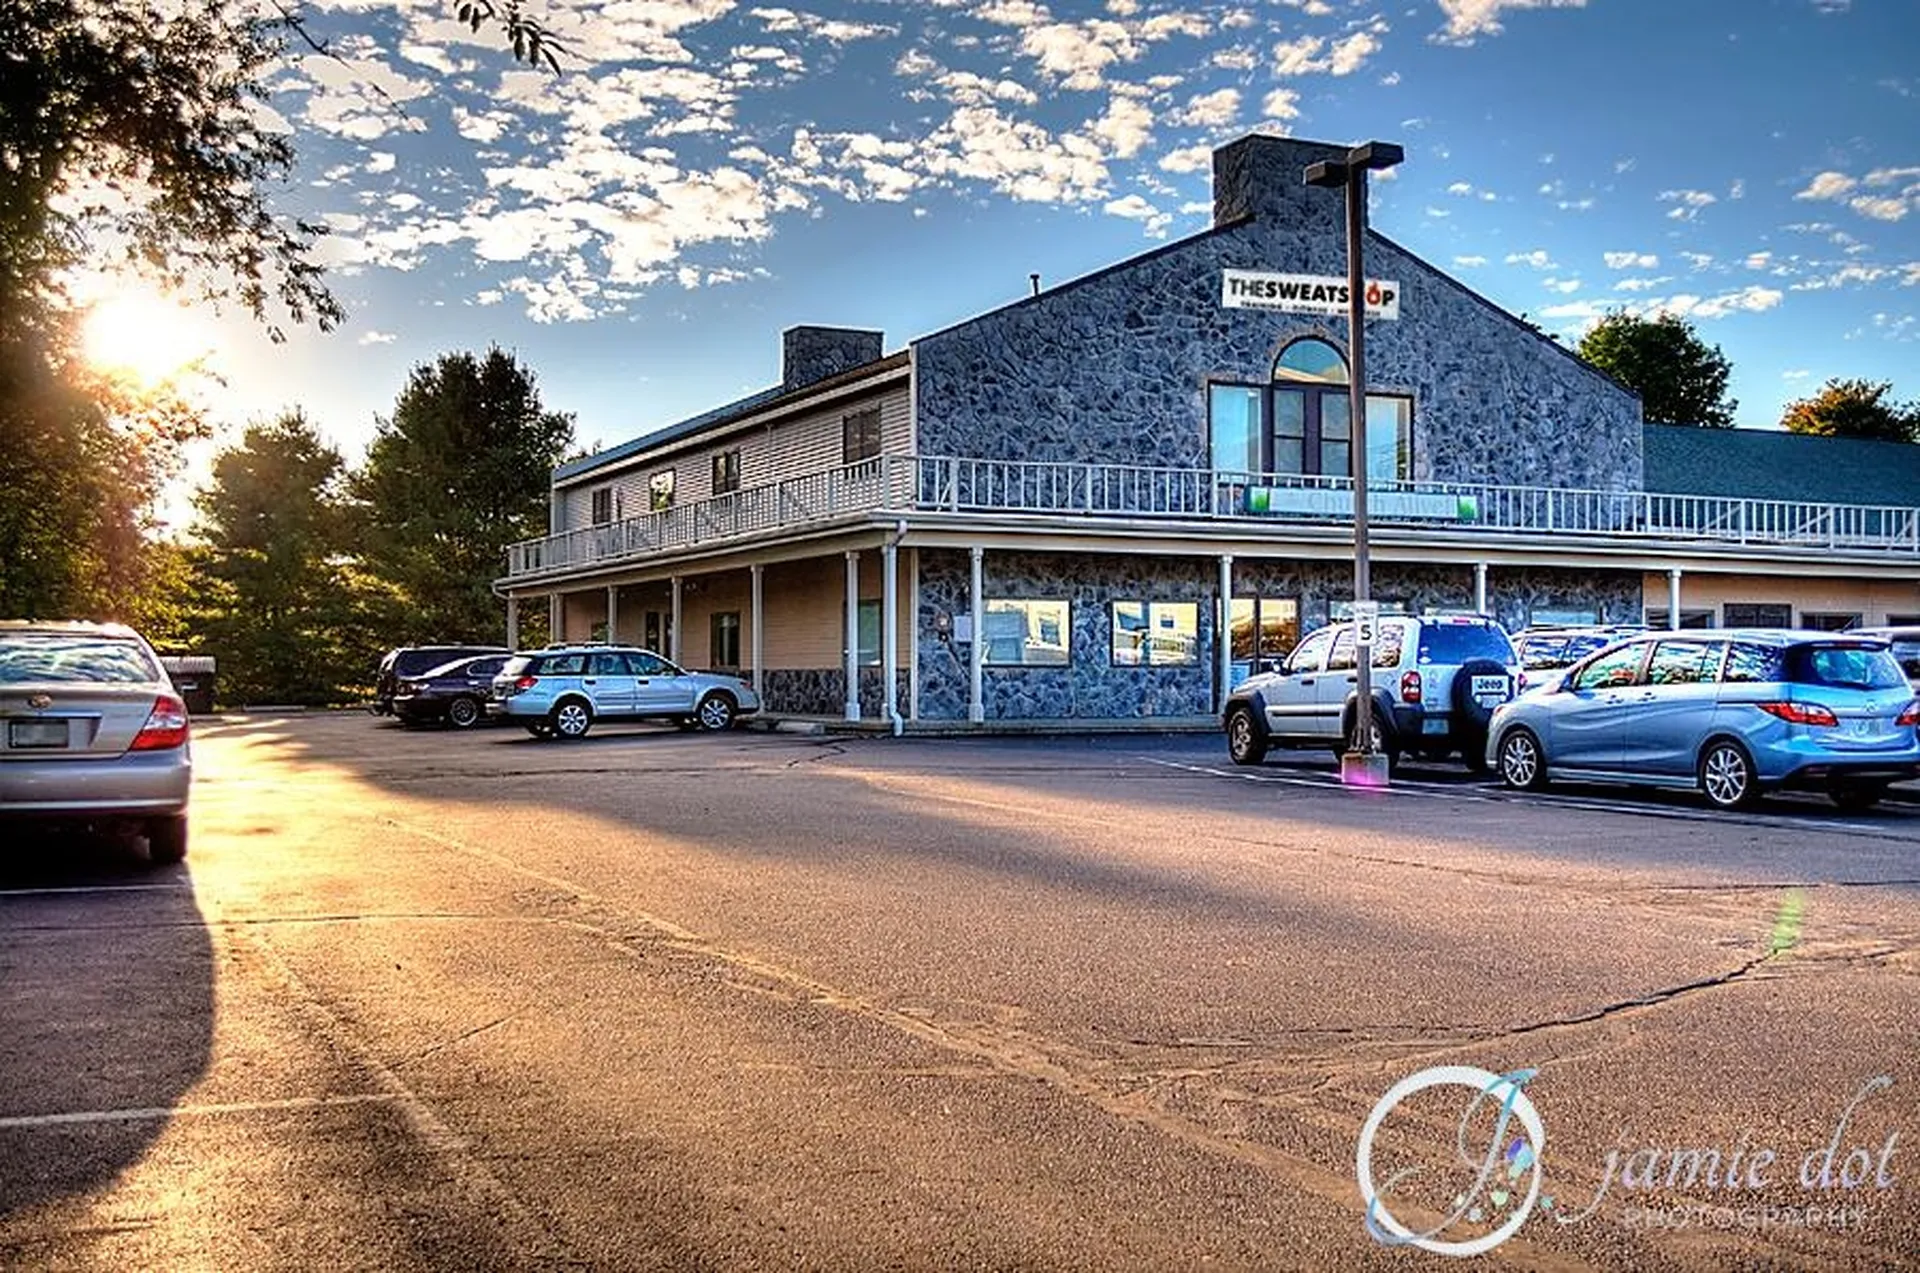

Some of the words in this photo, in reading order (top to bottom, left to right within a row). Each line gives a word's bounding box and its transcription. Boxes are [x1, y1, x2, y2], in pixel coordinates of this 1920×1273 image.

[1308, 491, 1385, 513] Chuh
[1360, 624, 1373, 641] 5
[1477, 678, 1503, 690] Jeep
